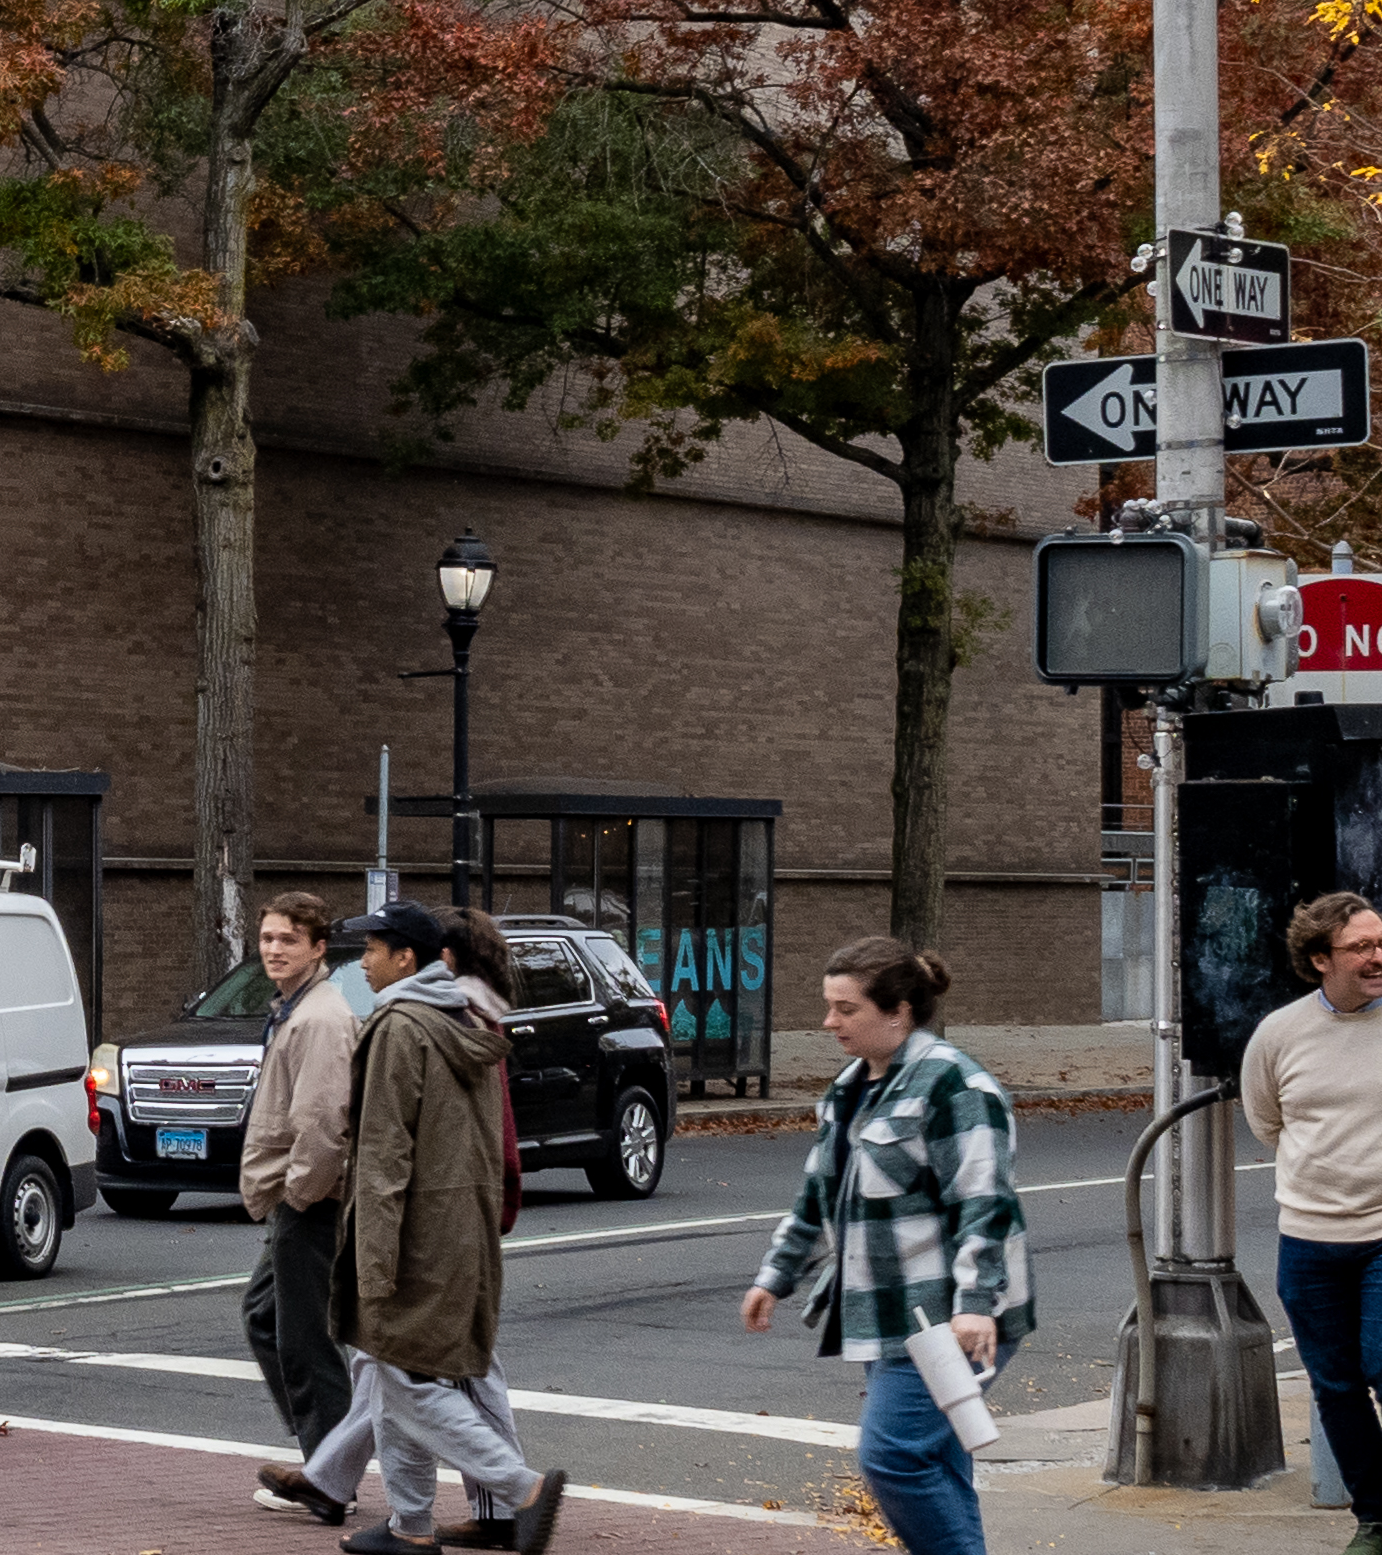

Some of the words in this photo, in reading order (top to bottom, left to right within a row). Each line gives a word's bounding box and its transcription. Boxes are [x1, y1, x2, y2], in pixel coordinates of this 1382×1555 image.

[1190, 265, 1224, 307] ONE
[1234, 272, 1268, 313] WAY
[1100, 388, 1157, 429] ON
[1221, 377, 1309, 419] WAY
[1298, 624, 1318, 658] O
[1345, 624, 1382, 658] N
[159, 1078, 216, 1094] GMC
